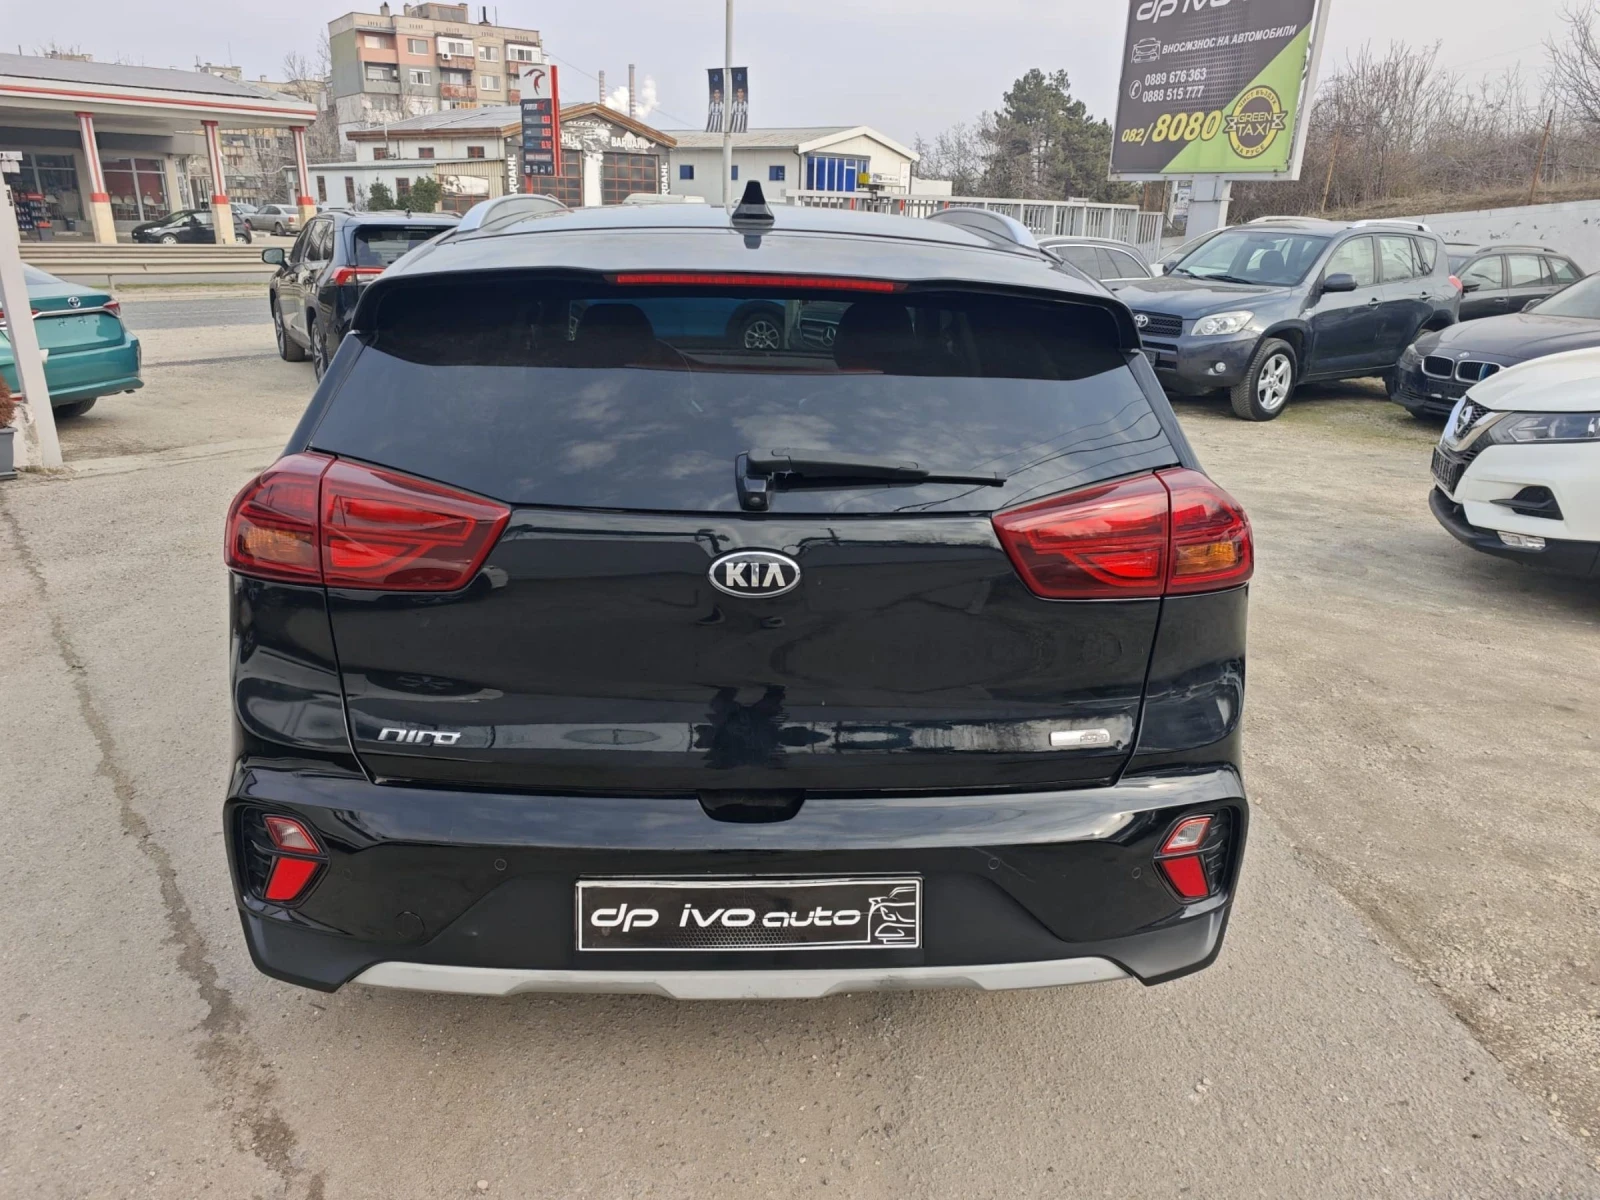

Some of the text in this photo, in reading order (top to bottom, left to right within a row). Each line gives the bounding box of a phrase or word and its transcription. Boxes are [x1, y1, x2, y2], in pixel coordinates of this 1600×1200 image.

[1217, 36, 1229, 47] НА
[1231, 24, 1298, 45] АВТОМОБИЛИ
[1145, 67, 1207, 86] 0889 676 363
[1142, 85, 1205, 103] 0888 515 777
[1237, 112, 1273, 122] GREEN
[1237, 122, 1271, 136] TAXI
[508, 153, 520, 195] RDAHL
[725, 562, 786, 588] KIA
[378, 727, 461, 745] niro
[590, 903, 861, 932] dp ivo auto
